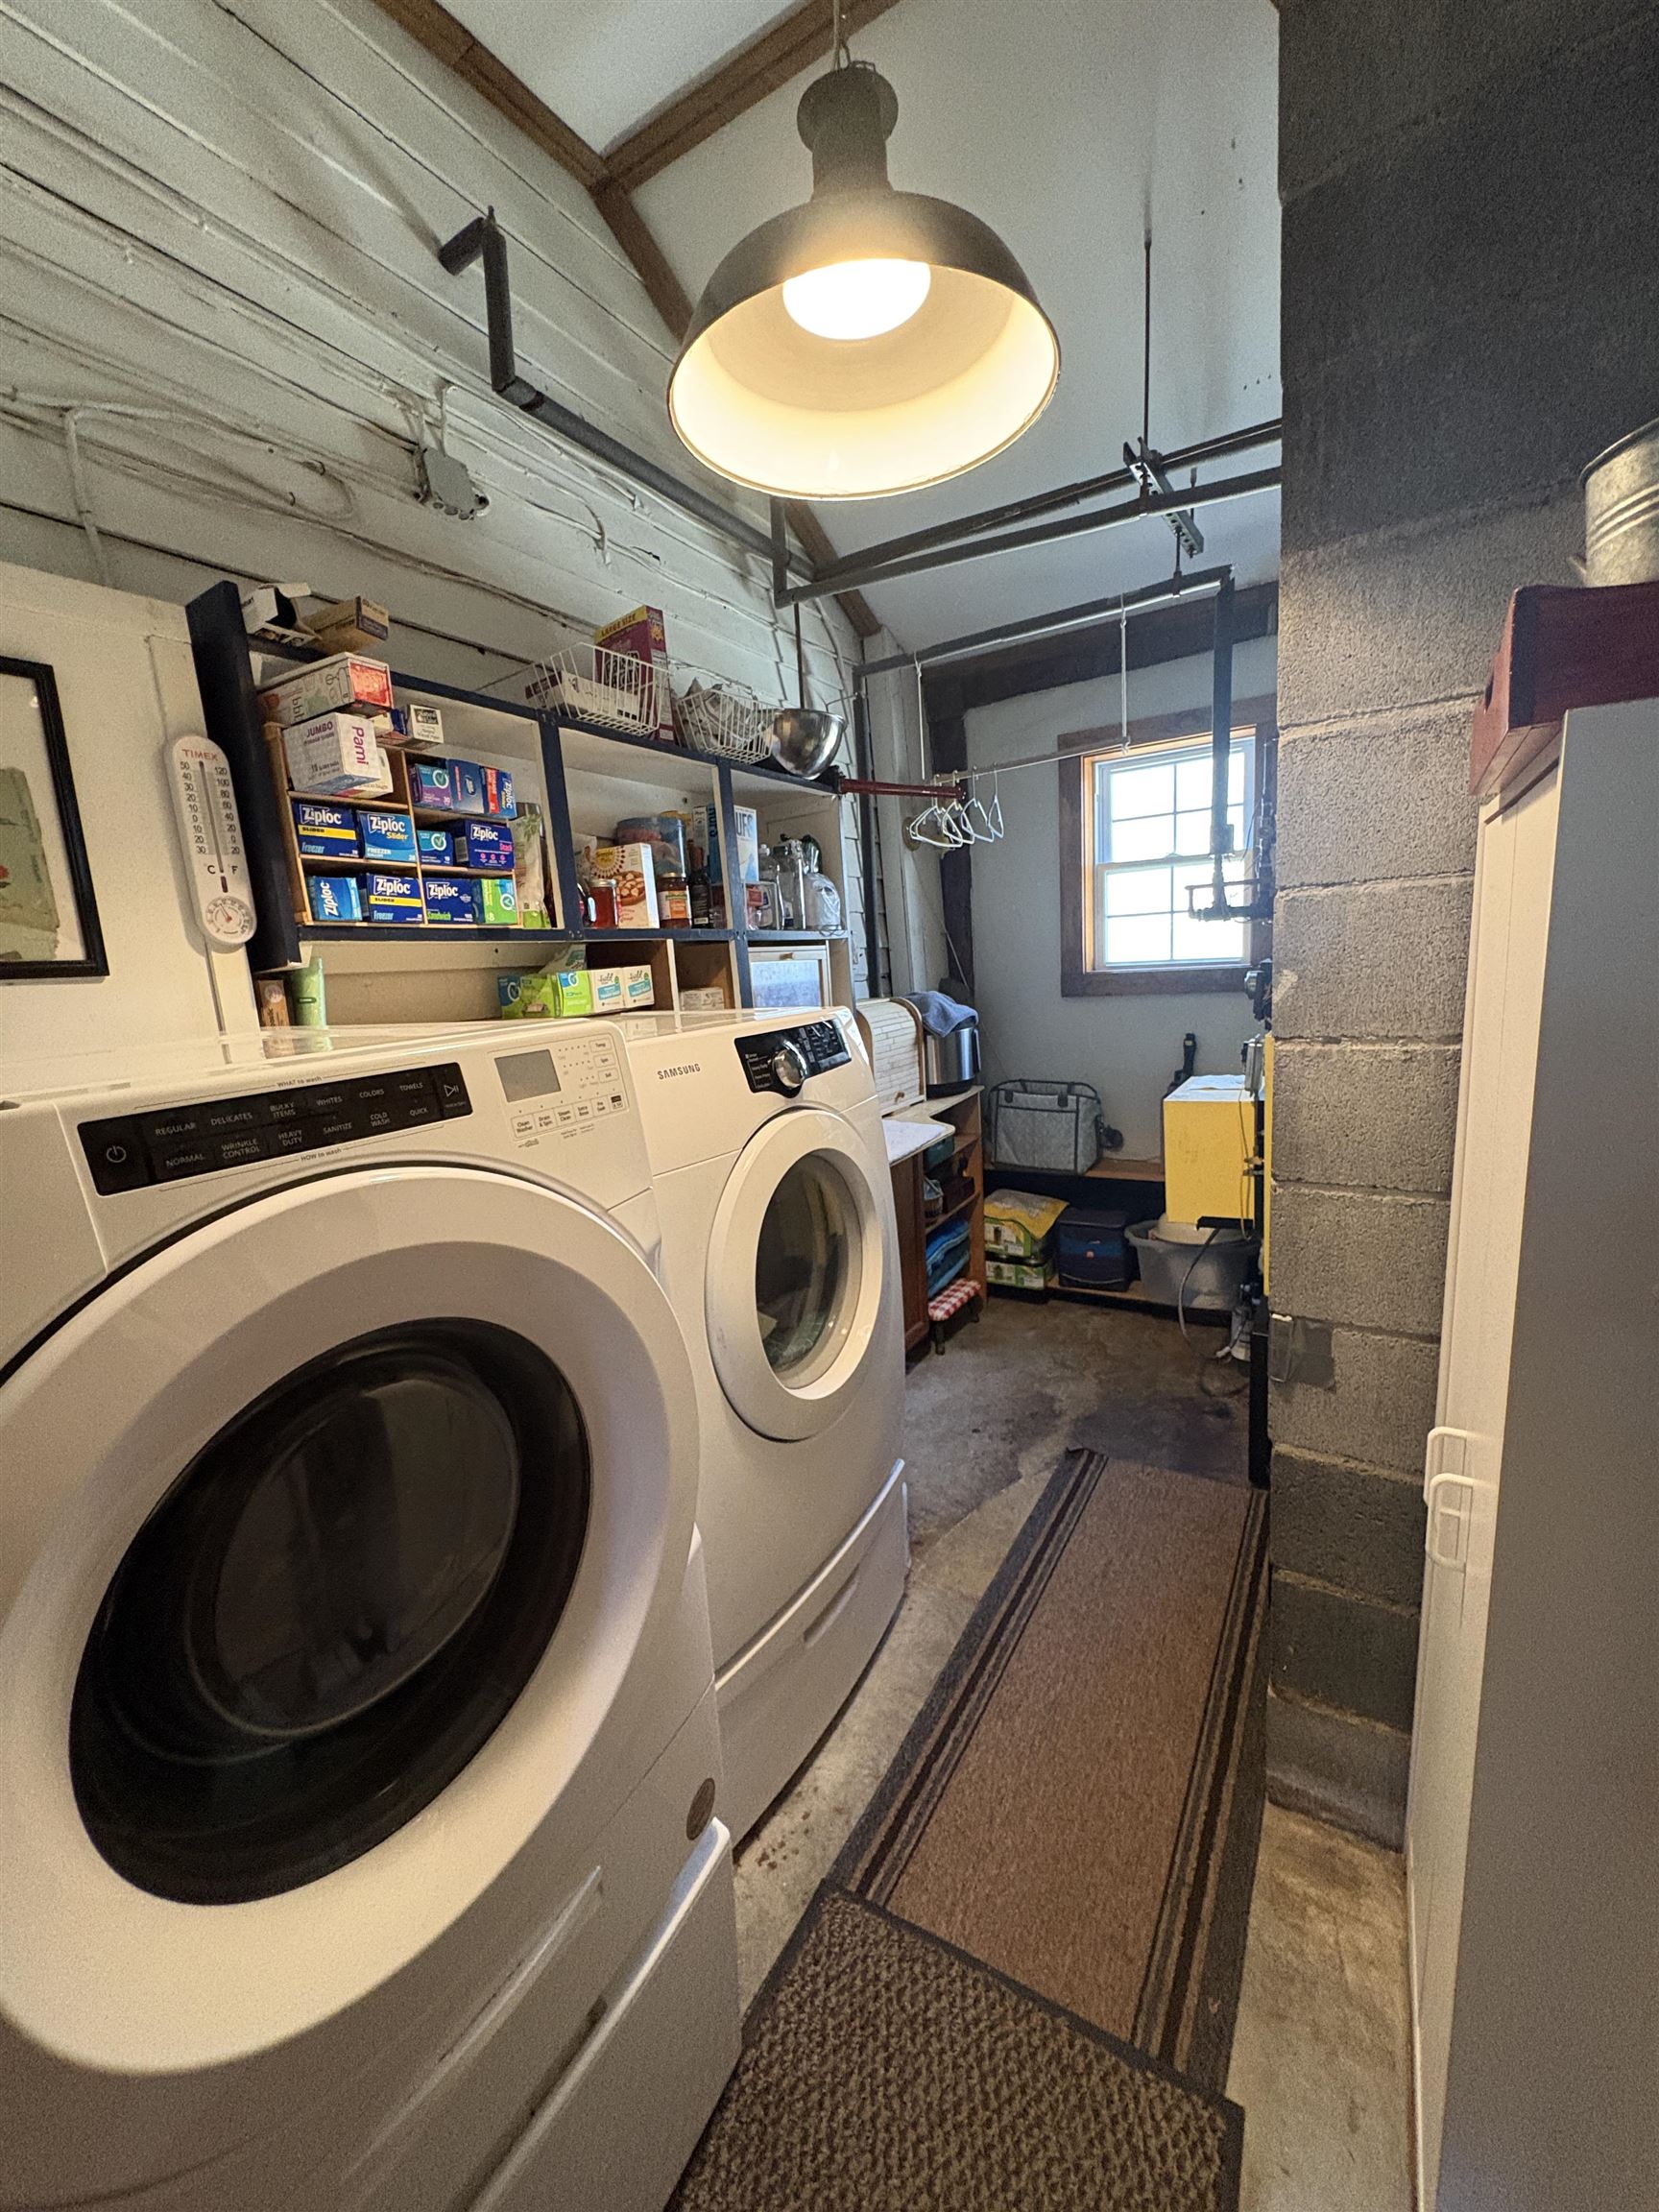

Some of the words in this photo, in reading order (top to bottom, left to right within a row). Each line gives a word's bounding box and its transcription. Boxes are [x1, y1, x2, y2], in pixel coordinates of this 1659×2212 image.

[601, 622, 622, 637] LARGE
[623, 613, 637, 627] SIZE
[306, 721, 334, 738] JUMBO
[182, 749, 219, 761] TIMEX
[180, 761, 189, 770] 50
[182, 772, 191, 781] 40
[215, 767, 227, 776] 120
[184, 782, 193, 791] 30
[217, 779, 229, 787] 100
[186, 793, 196, 803] 20
[221, 789, 229, 799] 80
[504, 781, 514, 809] Ziploc
[189, 805, 198, 813] 10
[192, 814, 198, 823] 0
[225, 812, 233, 821] 40
[302, 807, 342, 826] Ziploc
[193, 825, 202, 833] 10
[228, 824, 236, 832] 20
[370, 816, 406, 834] Ziploc
[195, 835, 204, 844] 20
[231, 835, 236, 844] 0
[386, 831, 408, 840] Slider
[473, 827, 499, 842] Ziploc
[197, 846, 205, 854] 30
[231, 846, 240, 854] 20
[301, 841, 325, 854] Freezer
[367, 847, 392, 855] FREEZER
[207, 865, 216, 875] C
[231, 866, 238, 875] F
[376, 878, 411, 896] Ziploc
[429, 884, 459, 901] Ziploc
[321, 880, 339, 916] Ziploc
[373, 910, 395, 921] Freezer
[427, 911, 451, 921] Sandwich
[657, 1062, 702, 1081] SAMSUNG
[276, 1079, 296, 1088] WHAT
[398, 1081, 424, 1092] TOWELS
[359, 1088, 385, 1099] COLORS
[316, 1095, 344, 1107] WHITES
[270, 1101, 295, 1113] BULKY
[409, 1106, 429, 1118] QUICK
[273, 1109, 296, 1119] ITEMS
[370, 1111, 389, 1121] COLD
[210, 1112, 253, 1127] DELICATES
[371, 1118, 391, 1128] WASH
[517, 1119, 531, 1128] Clean
[155, 1122, 196, 1137] REGULAR
[323, 1121, 353, 1135] SANITIZE
[517, 1125, 534, 1134] Washer
[277, 1129, 302, 1141] HEAVY
[221, 1138, 257, 1152] WRINKLE
[282, 1136, 303, 1147] DUTY
[223, 1145, 260, 1160] CONTROL
[326, 1147, 342, 1156] wash
[165, 1152, 205, 1168] NORMAL
